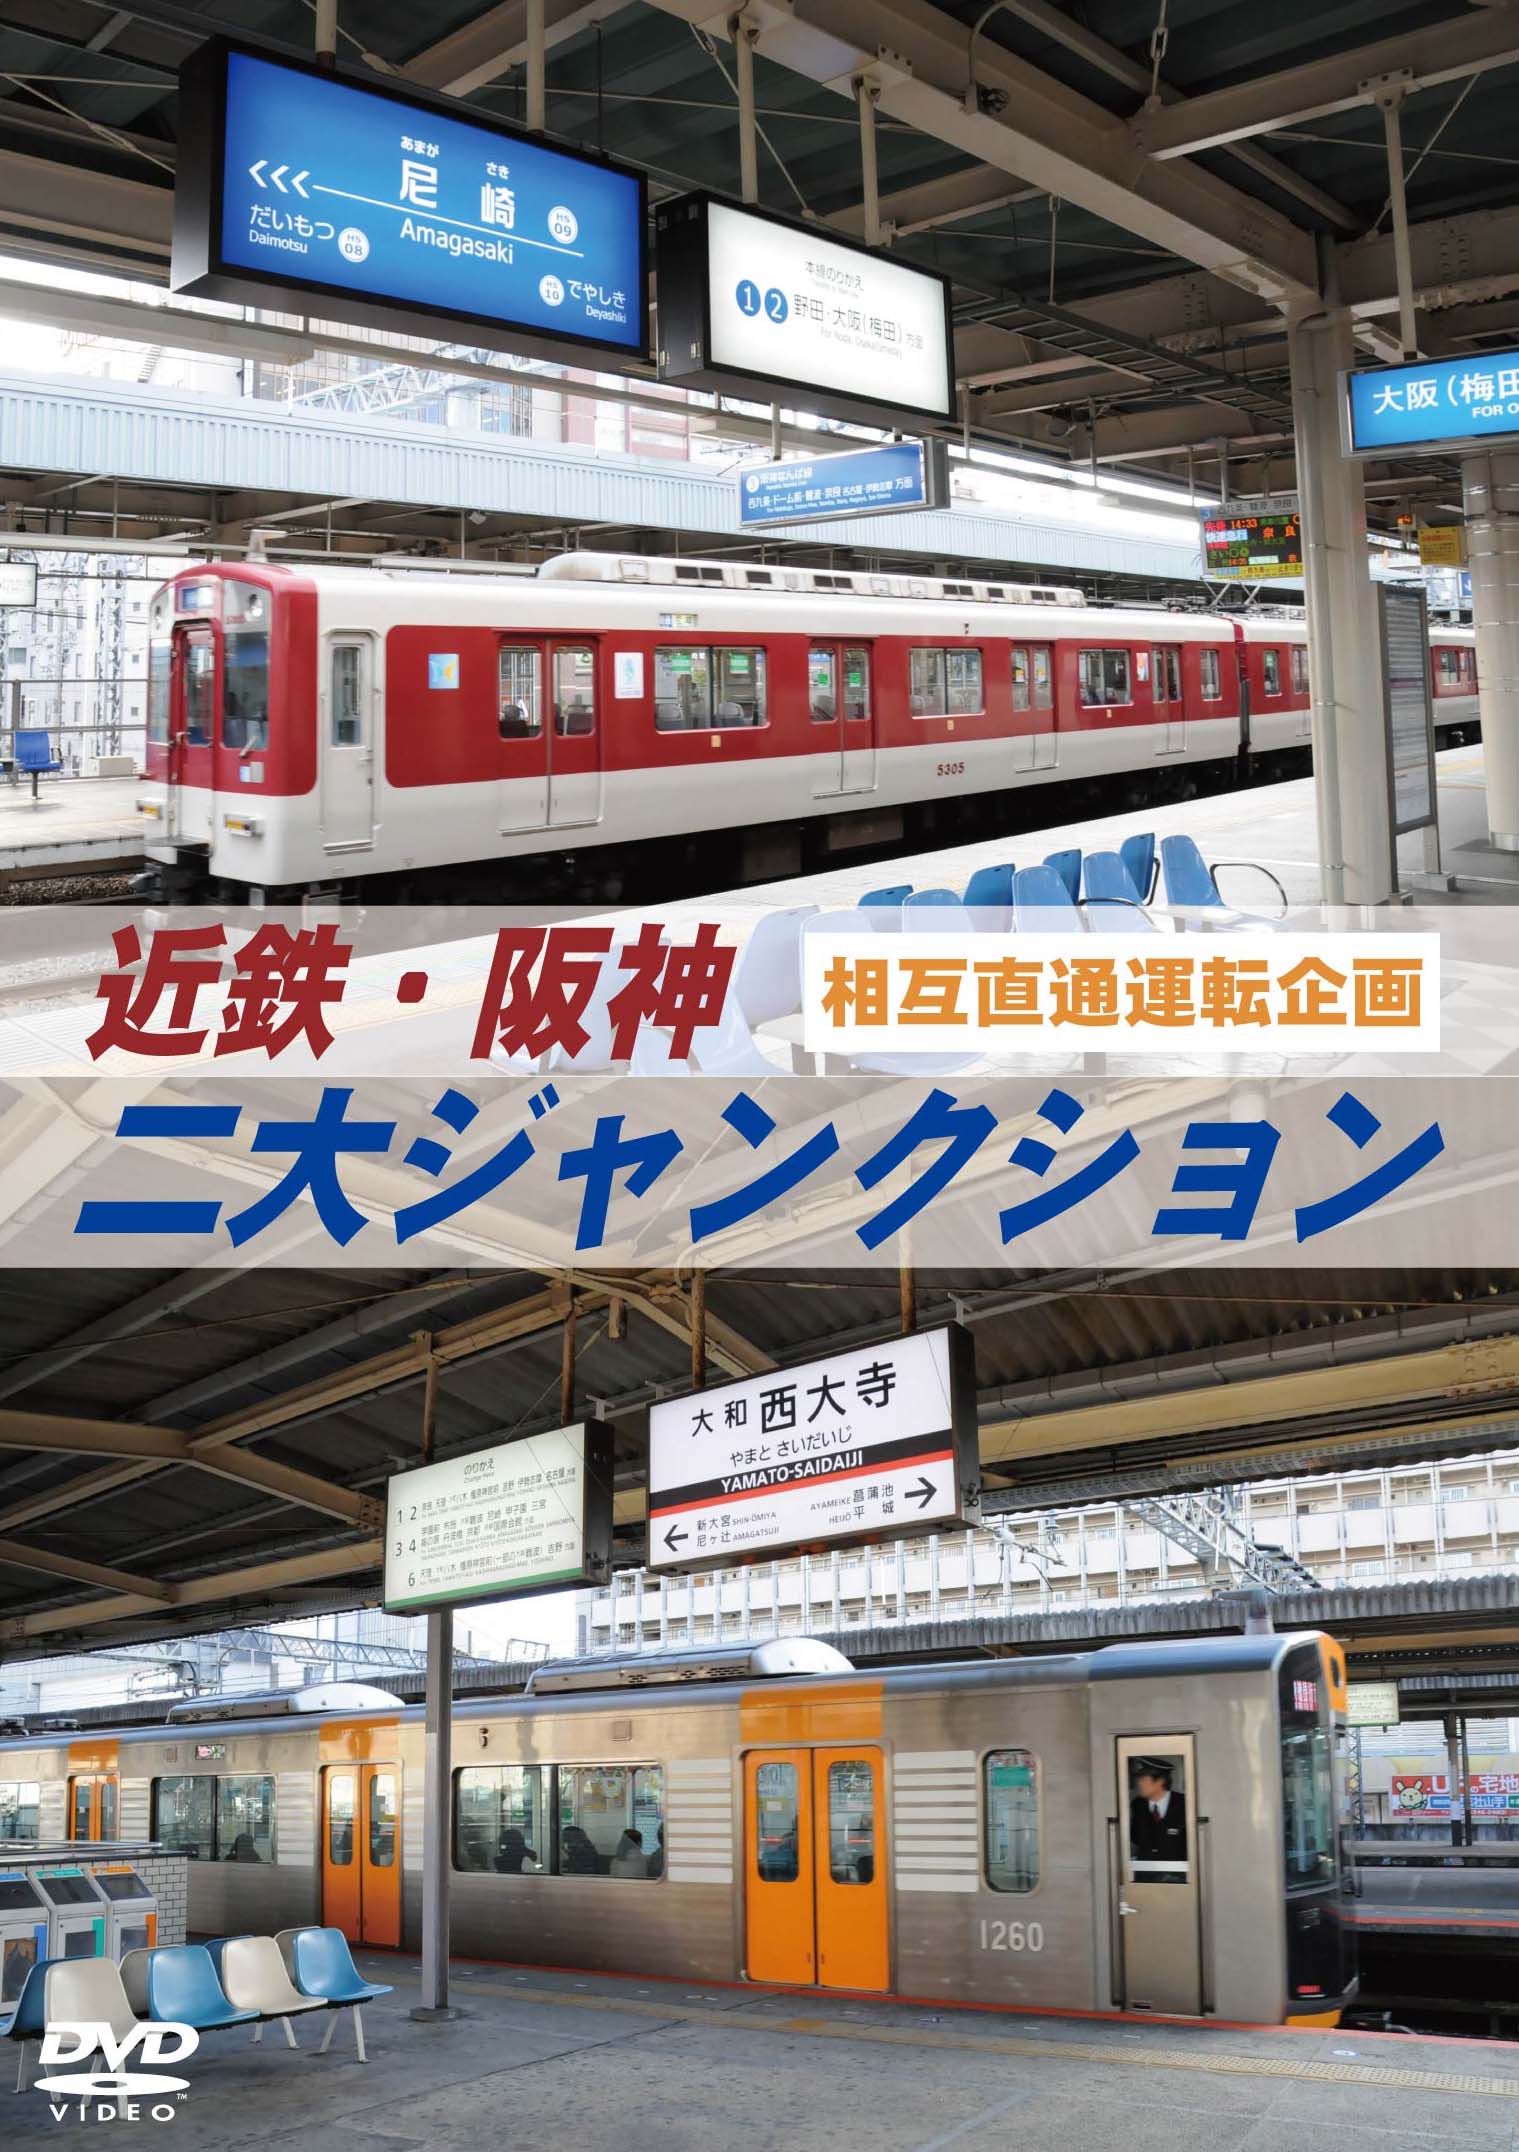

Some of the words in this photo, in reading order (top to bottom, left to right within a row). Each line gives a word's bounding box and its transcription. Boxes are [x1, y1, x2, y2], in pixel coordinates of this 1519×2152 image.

[400, 135, 439, 159] あまが
[486, 162, 510, 181] さき
[400, 159, 515, 230] 尼崎
[249, 203, 335, 239] だいもつ
[555, 213, 571, 222] HS
[553, 222, 573, 236] 09
[248, 229, 308, 255] Daimotsu
[347, 234, 363, 243] HS
[400, 217, 514, 265] Amagasaki
[344, 242, 364, 257] 08
[545, 288, 560, 301] 10
[567, 277, 627, 309] でやしき
[586, 305, 627, 324] Deyashiki
[1472, 404, 1503, 419] FOR
[895, 476, 913, 490] 方面
[1231, 518, 1258, 529] 14:33
[937, 762, 965, 776] 5305
[691, 1398, 747, 1438] 大和
[759, 1361, 897, 1434] 西大寺
[729, 1445, 772, 1468] やまと
[776, 1424, 853, 1457] さいだいじ
[720, 1450, 864, 1495] YAMATO-SAIDAIJI
[810, 1496, 851, 1511] AYAMEIKE
[410, 1506, 417, 1520] 2
[697, 1514, 731, 1531] 新大宮
[733, 1527, 780, 1541] AMAGATSUJI
[395, 1542, 402, 1557] 3
[409, 1539, 416, 1552] 4
[408, 1572, 416, 1587] 6
[981, 1920, 1044, 1952] 1260
